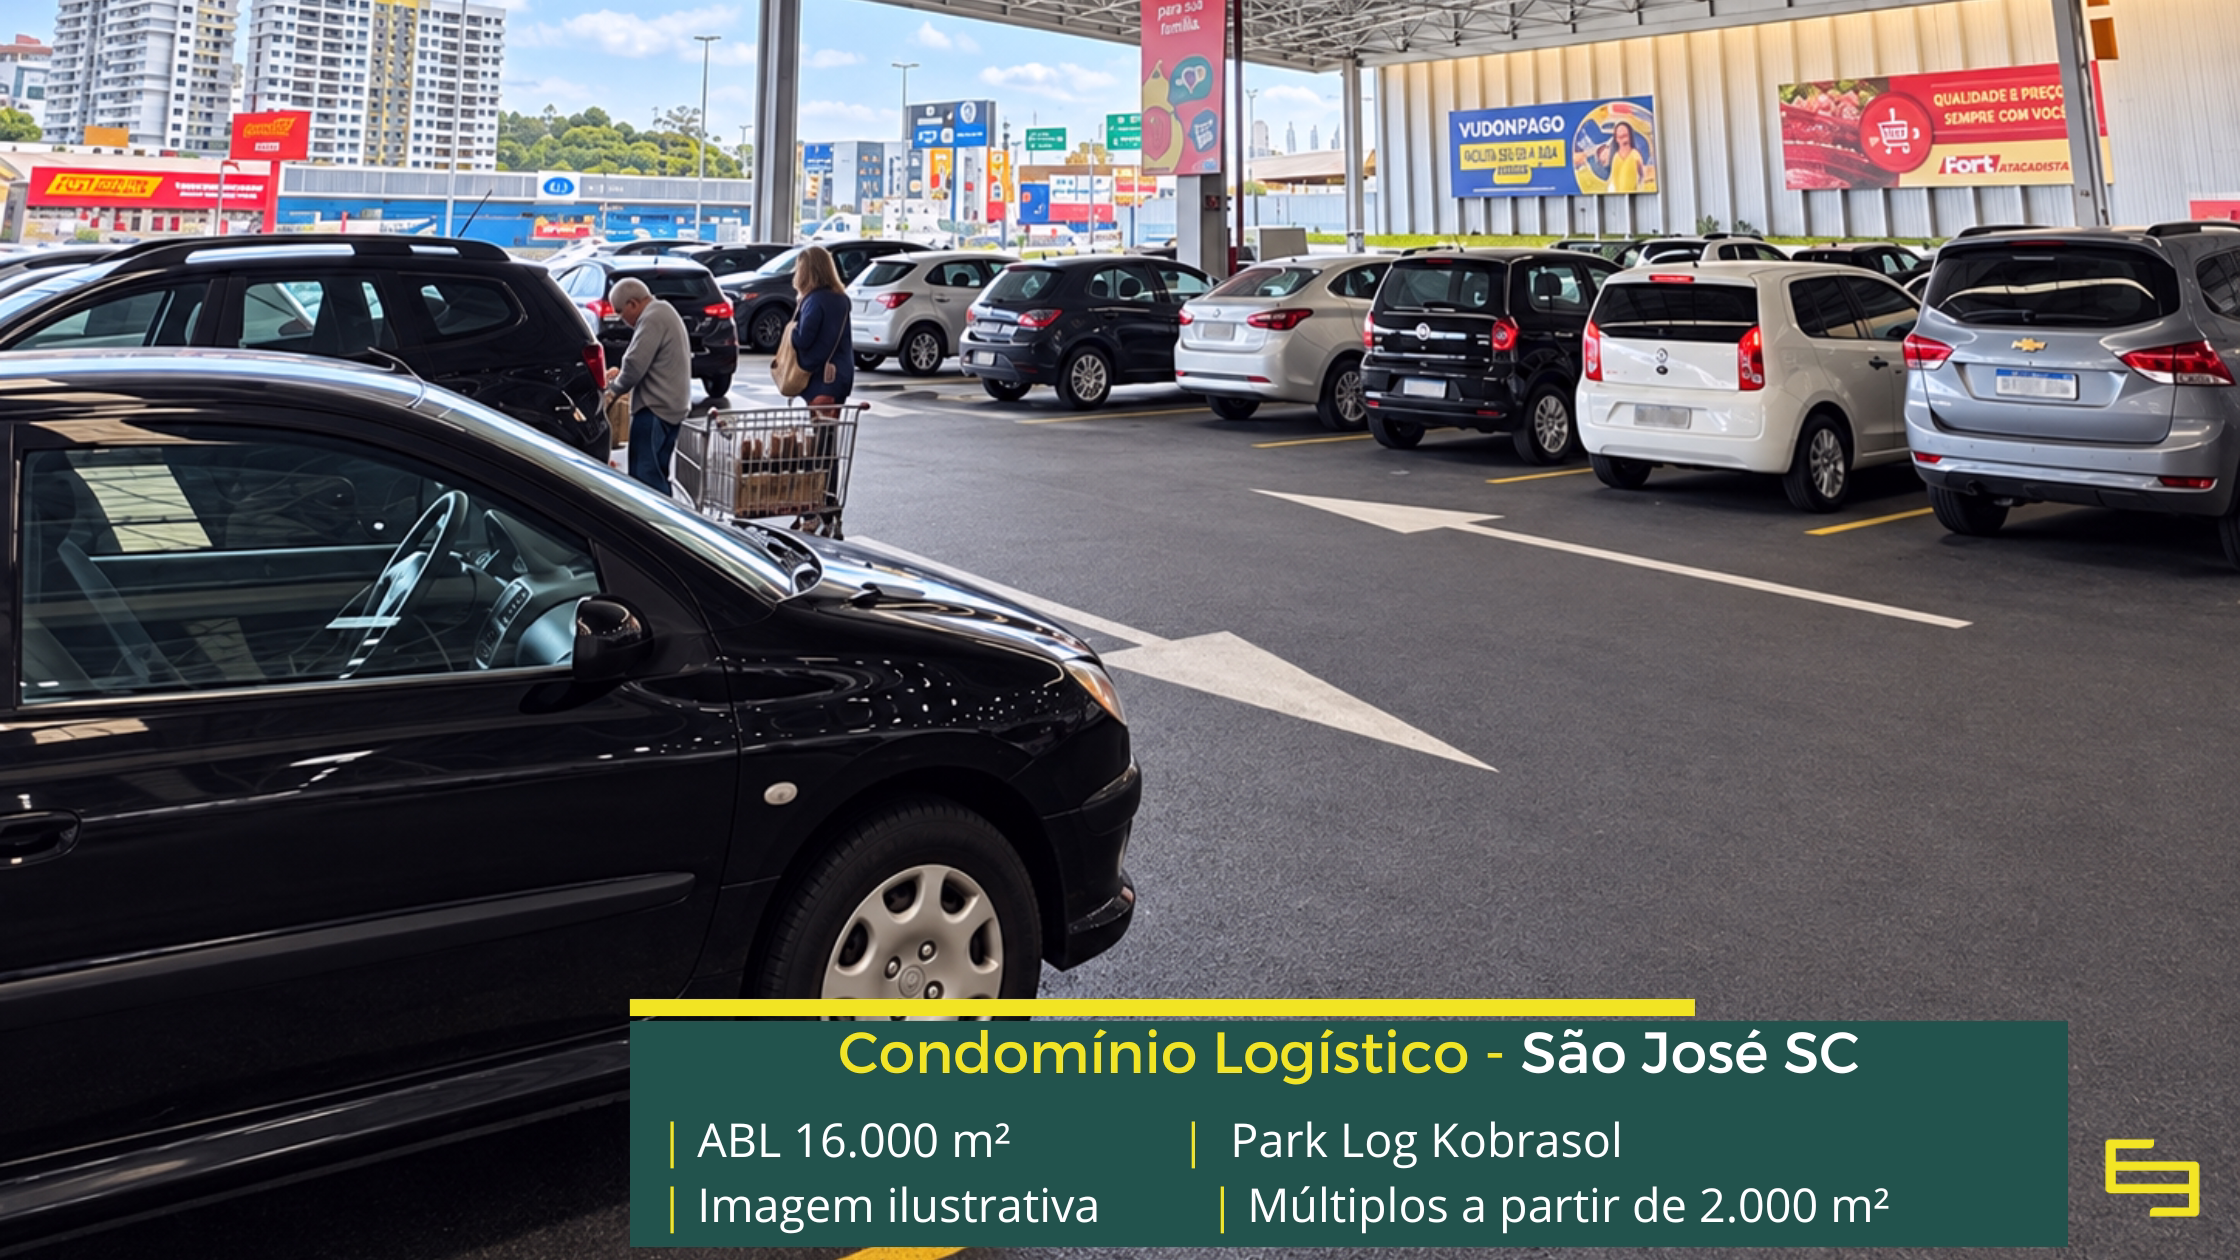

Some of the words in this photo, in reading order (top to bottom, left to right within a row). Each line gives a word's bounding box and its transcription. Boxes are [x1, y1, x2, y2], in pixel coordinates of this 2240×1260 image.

[1933, 89, 2007, 107] QUALIDADE
[1944, 109, 1996, 125] SEMPRE
[1999, 107, 2029, 122] COM
[1458, 115, 1565, 139] VUDONPAGO
[1945, 154, 1994, 174] Fort
[1999, 161, 2069, 173] ATACADISTA
